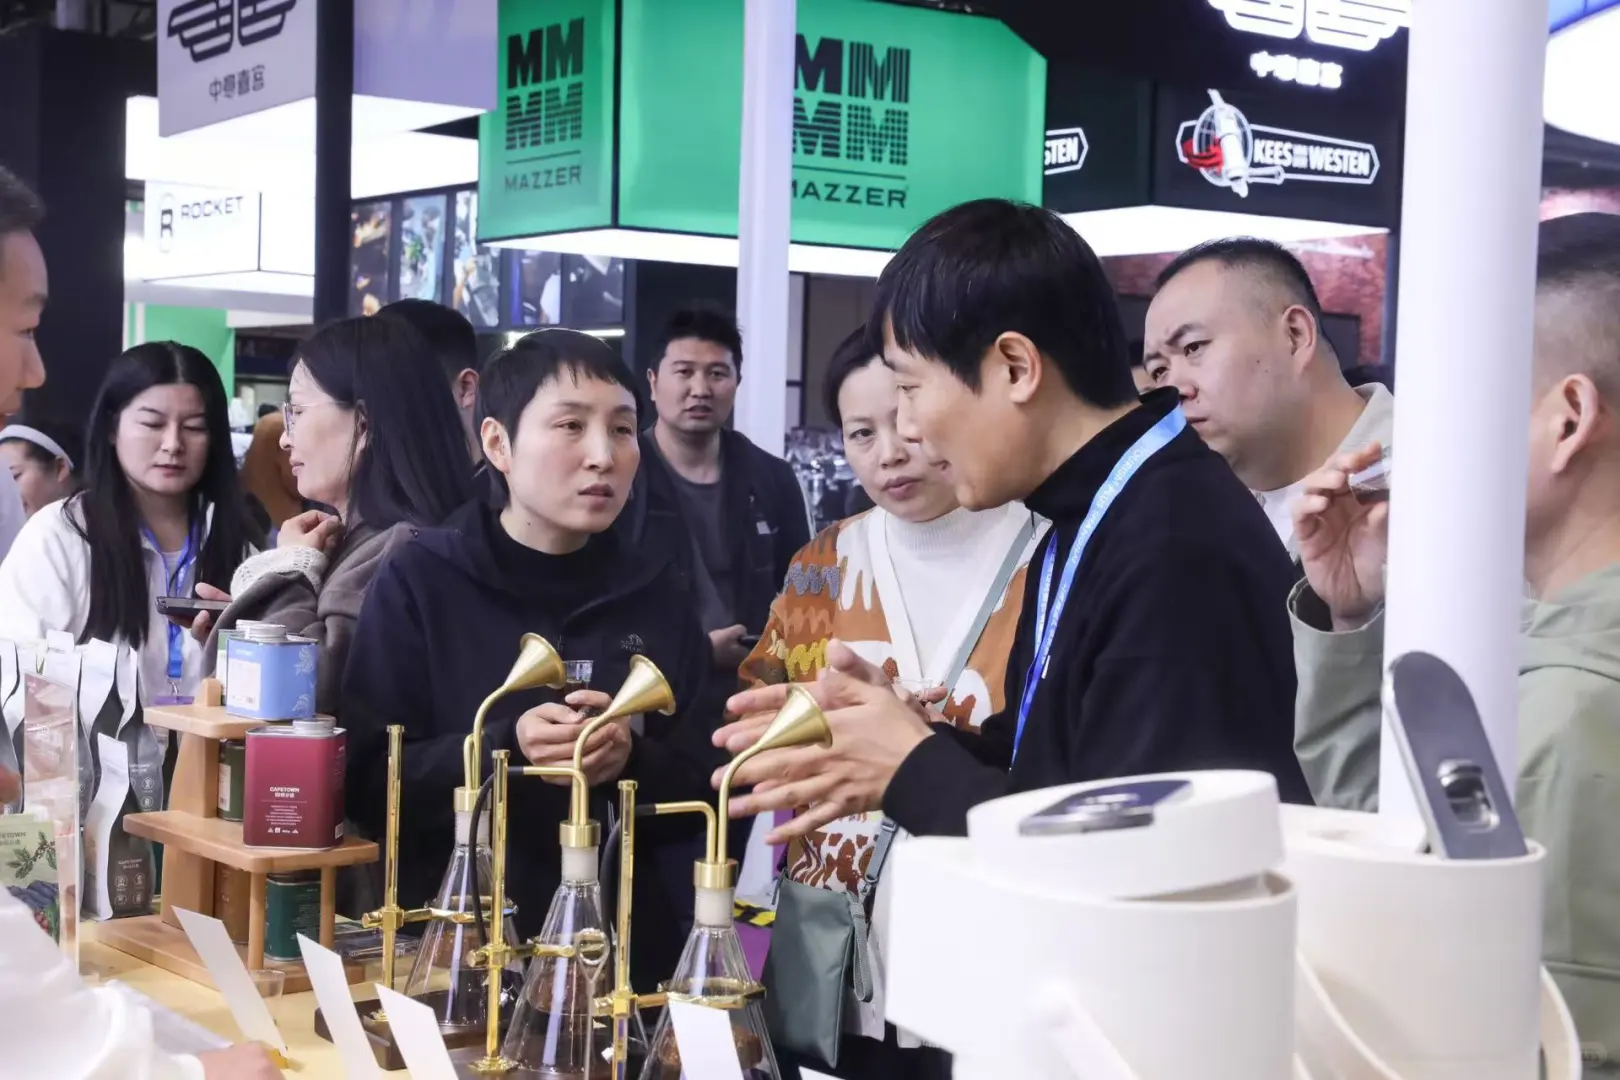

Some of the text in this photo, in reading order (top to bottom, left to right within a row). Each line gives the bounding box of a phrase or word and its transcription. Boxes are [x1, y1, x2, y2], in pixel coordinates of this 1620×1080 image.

[1253, 138, 1293, 168] KEES
[1309, 145, 1371, 176] WESTEN
[504, 165, 582, 194] MAZZER
[181, 195, 244, 220] ROCKET
